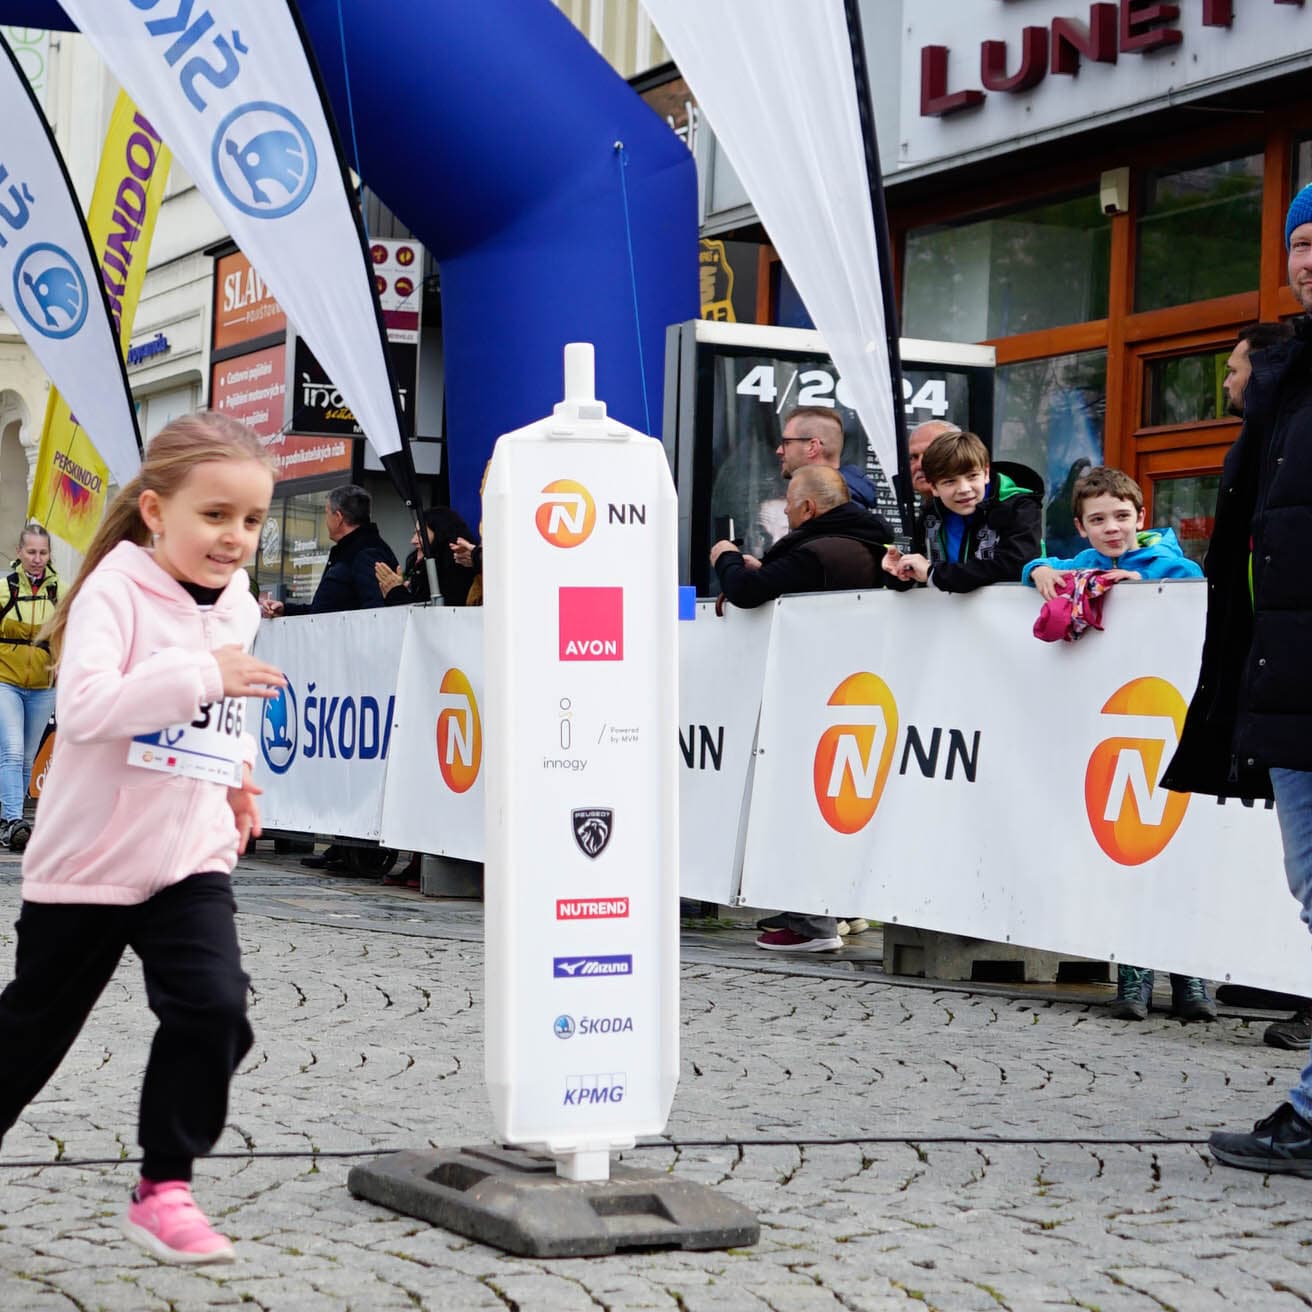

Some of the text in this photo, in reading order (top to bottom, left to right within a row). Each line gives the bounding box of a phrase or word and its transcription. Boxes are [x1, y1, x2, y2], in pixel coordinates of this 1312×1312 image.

[53, 450, 103, 495] PERSKINDOL
[608, 503, 646, 525] NN
[565, 640, 617, 655] AVON
[543, 756, 588, 771] innogy
[899, 725, 981, 783] NN
[559, 902, 627, 918] NUTREND
[579, 1016, 634, 1035] ŠKODA
[563, 1086, 624, 1107] KPMG
